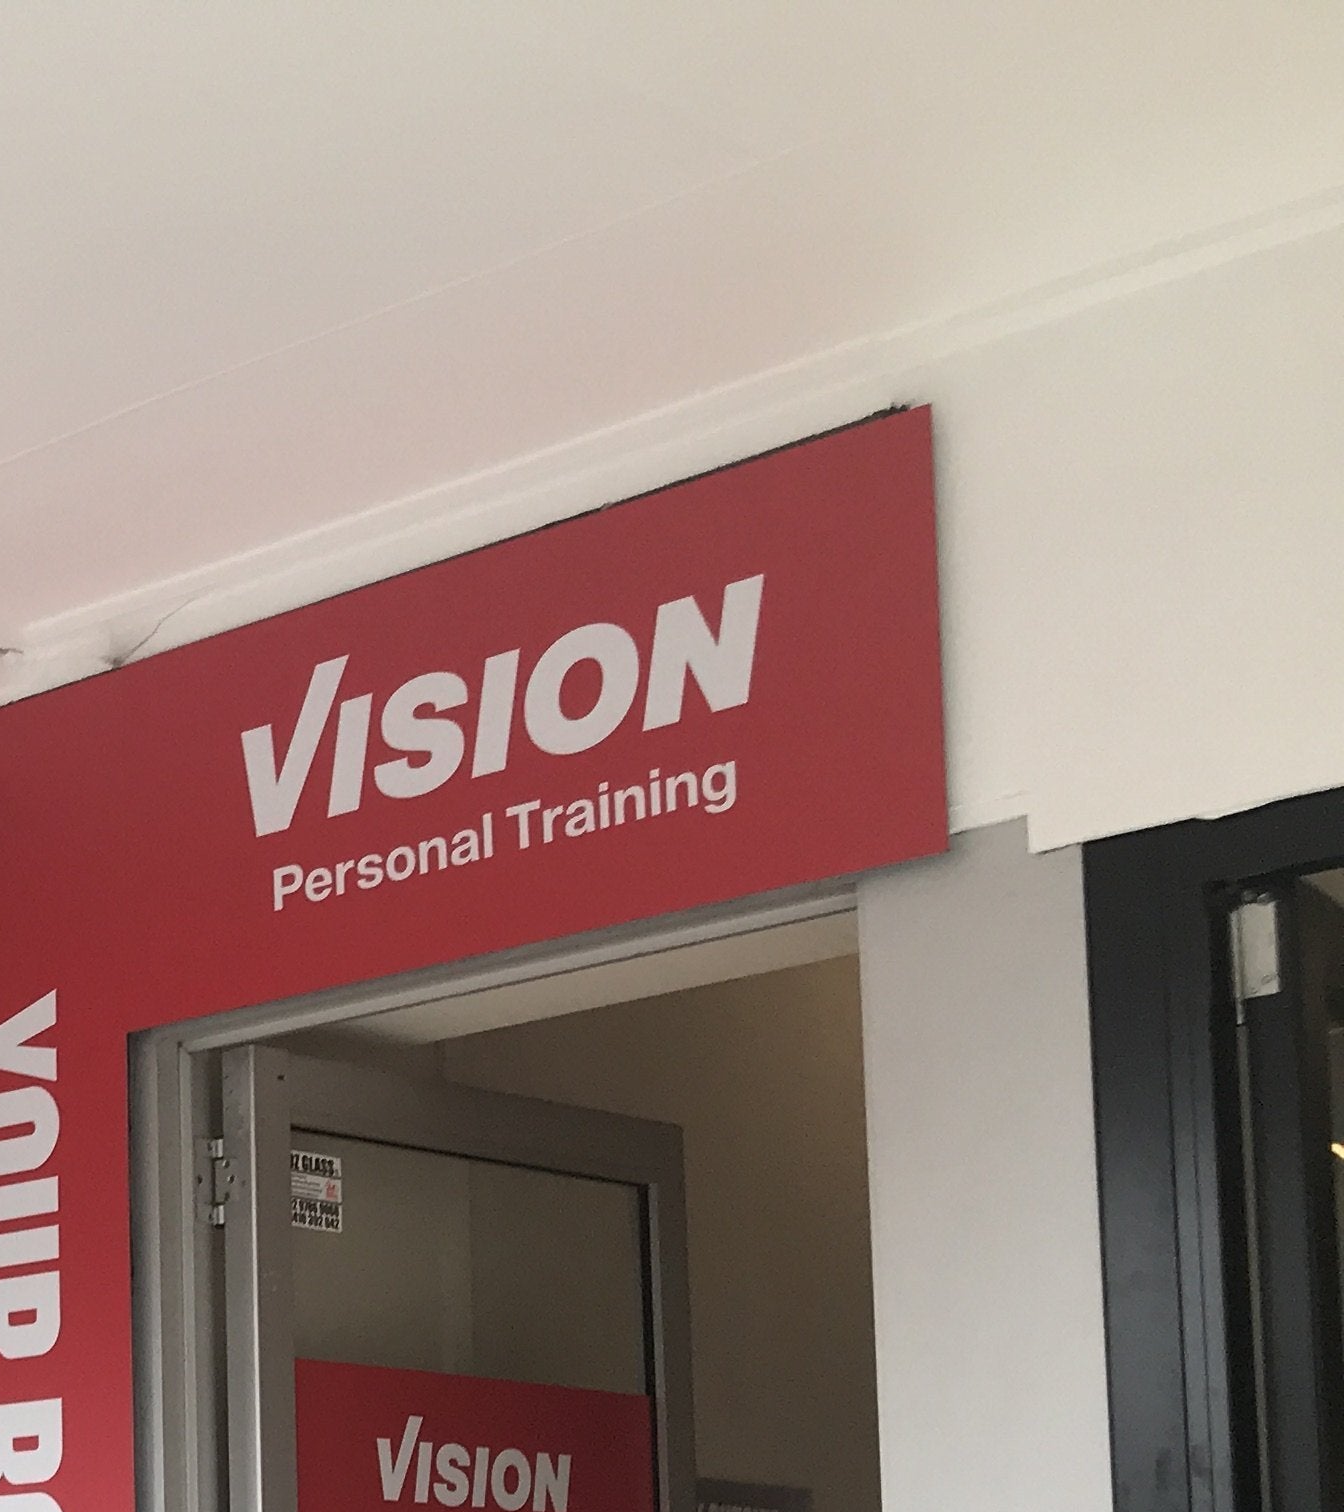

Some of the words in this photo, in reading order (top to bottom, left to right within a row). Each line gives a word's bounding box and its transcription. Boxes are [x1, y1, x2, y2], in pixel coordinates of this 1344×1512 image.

[240, 573, 764, 838] VISION
[272, 813, 494, 912] Personal
[505, 760, 738, 850] Training
